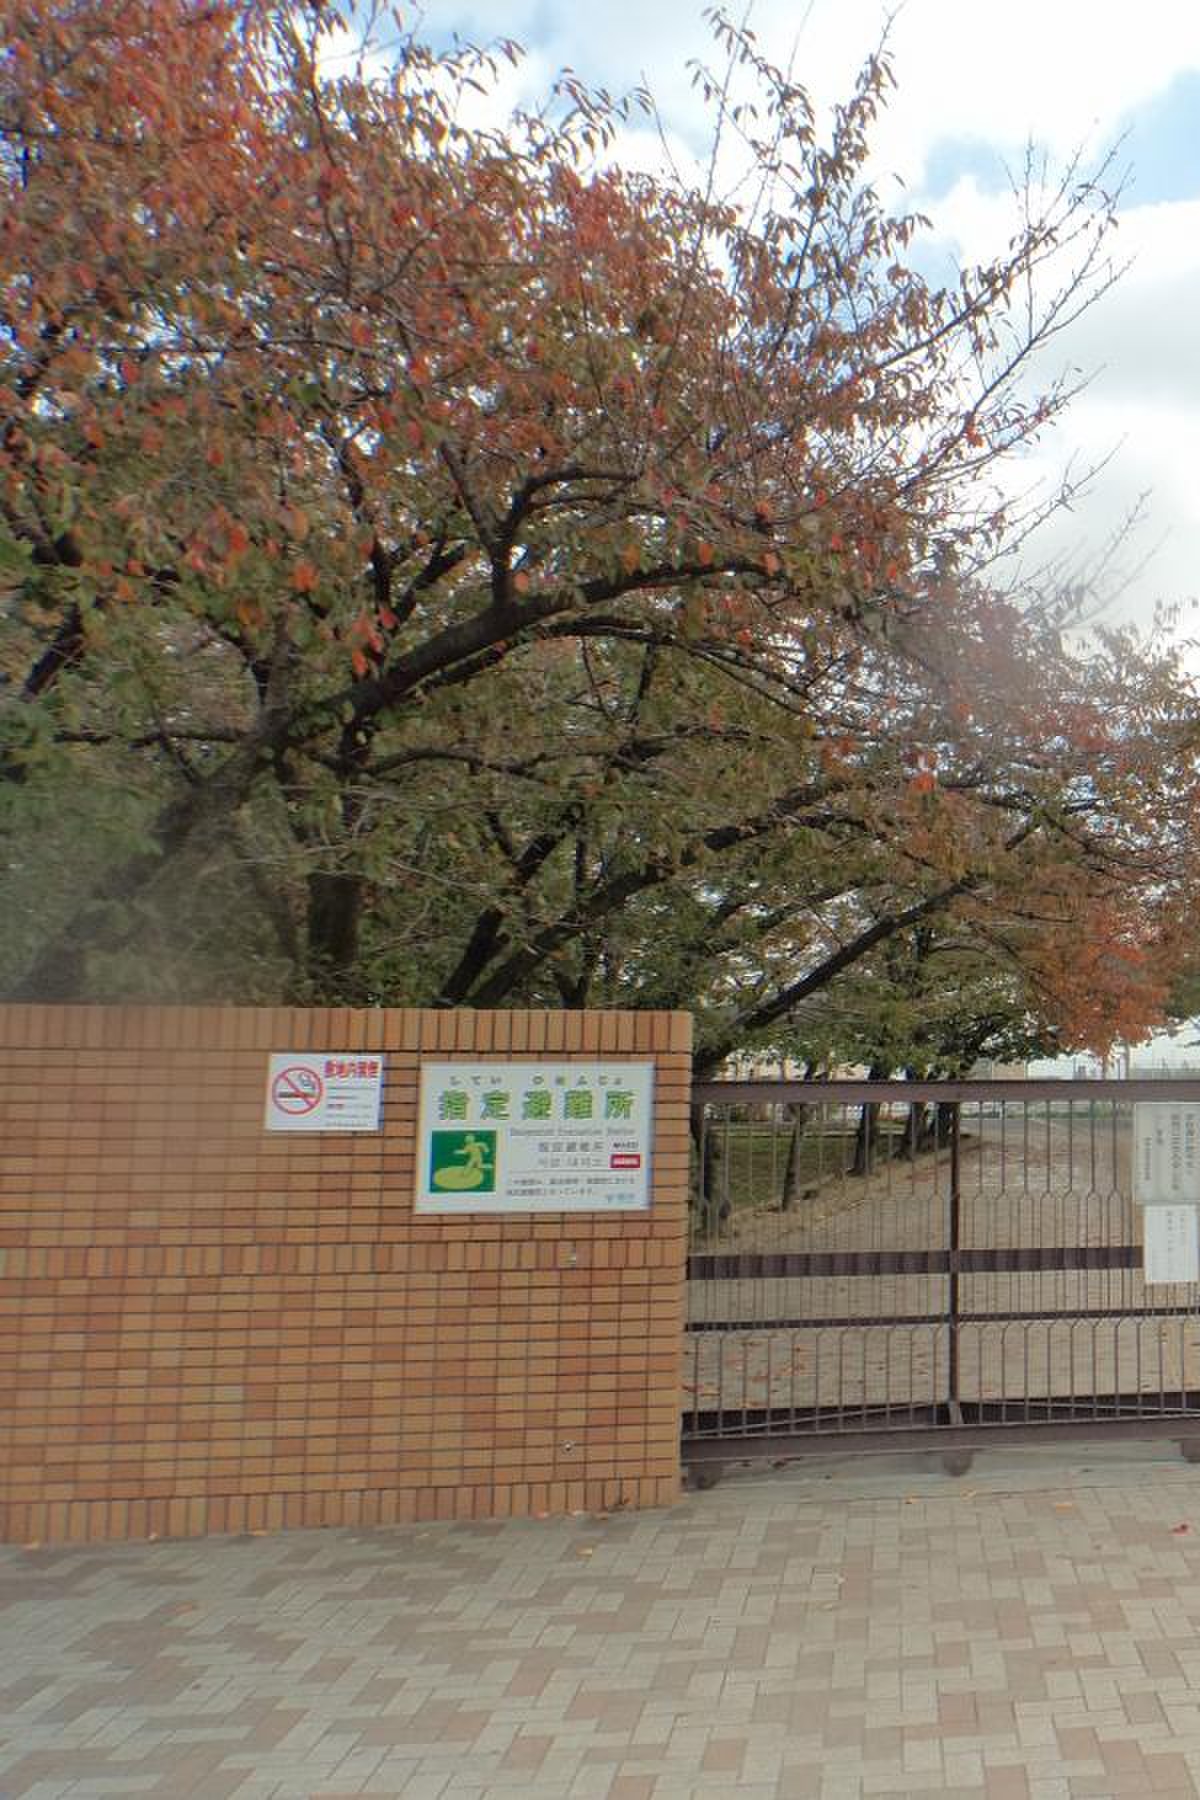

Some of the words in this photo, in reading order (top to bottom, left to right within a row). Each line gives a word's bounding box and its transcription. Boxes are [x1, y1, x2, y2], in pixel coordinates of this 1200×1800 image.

[439, 1089, 634, 1120] 指定避難所
